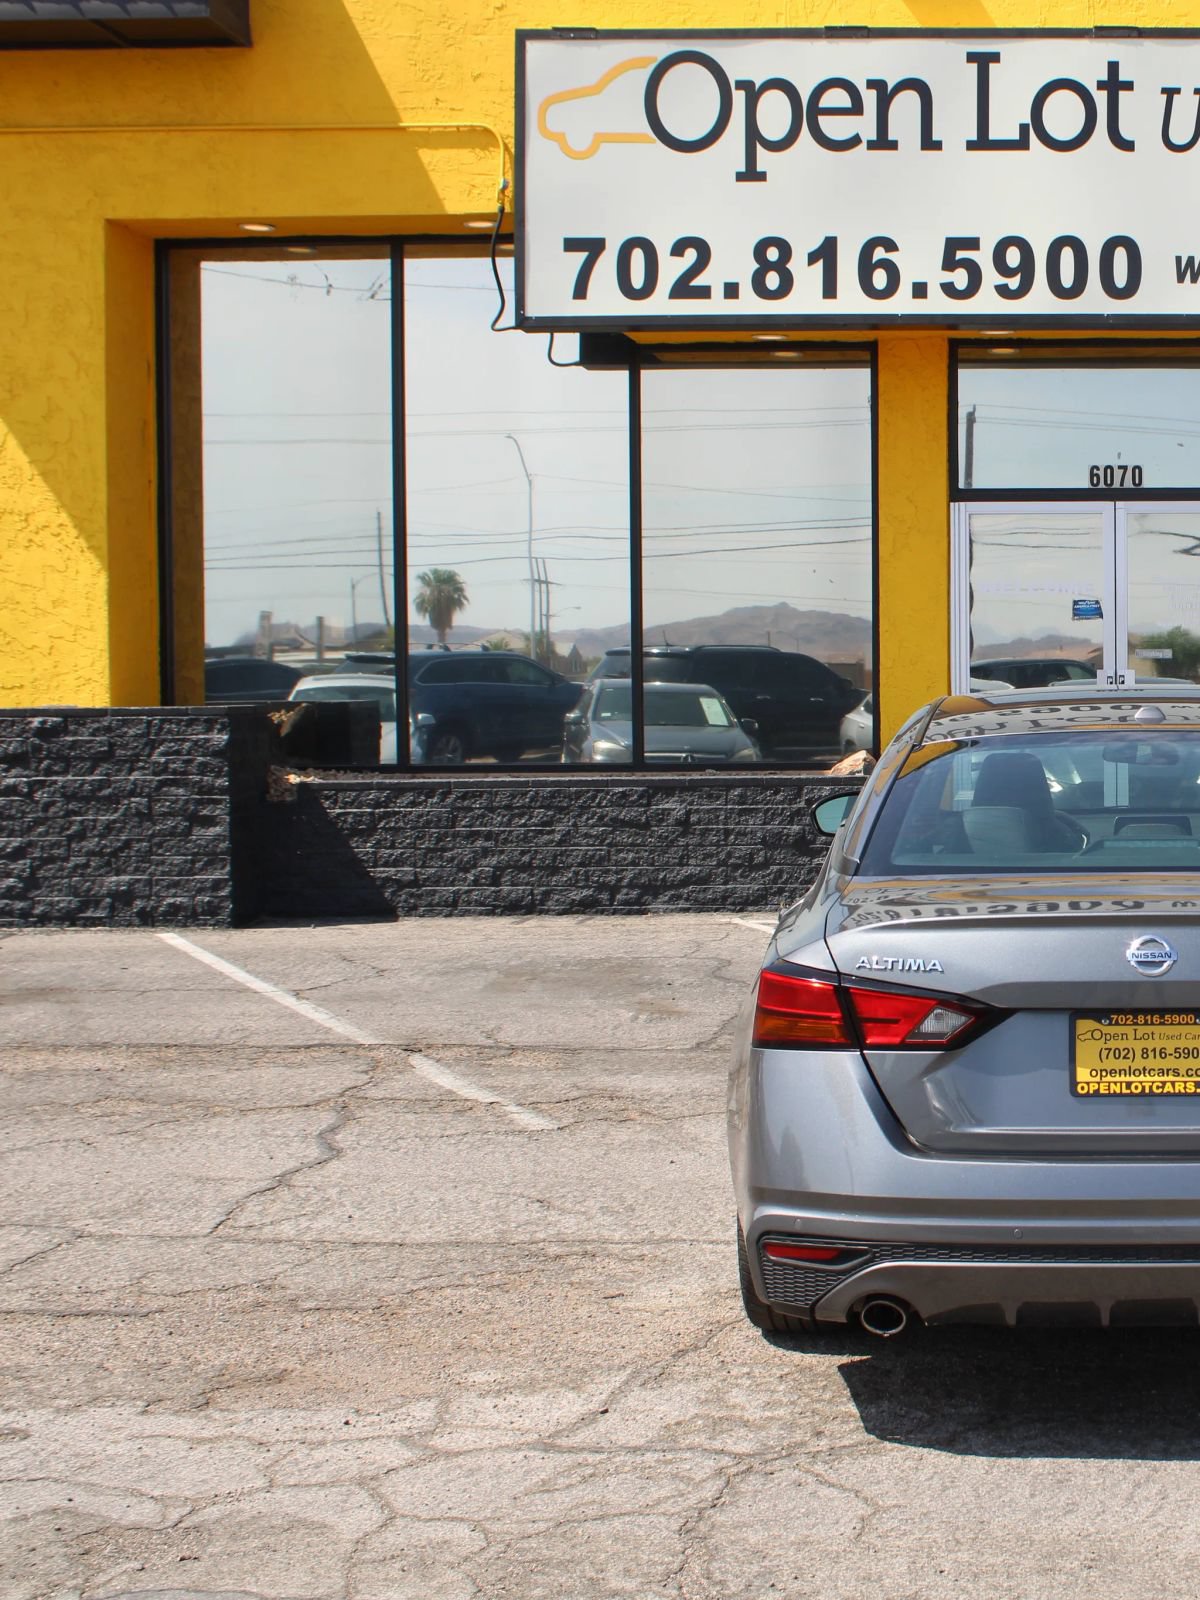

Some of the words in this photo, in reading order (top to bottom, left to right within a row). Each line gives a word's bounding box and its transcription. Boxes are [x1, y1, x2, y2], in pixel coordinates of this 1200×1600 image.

[644, 50, 943, 182] Open
[966, 52, 1136, 152] Lot
[562, 235, 1142, 301] 702.816.5900
[1089, 465, 1144, 488] 6070
[1131, 951, 1173, 960] NISSAN
[855, 956, 944, 972] ALTIMA
[1110, 1014, 1195, 1025] 702-816-5900
[1091, 1028, 1129, 1044] Open
[1132, 1028, 1156, 1041] Lot
[1158, 1032, 1182, 1041] Used
[1184, 1032, 1200, 1041] Car
[1098, 1047, 1136, 1062] (702)
